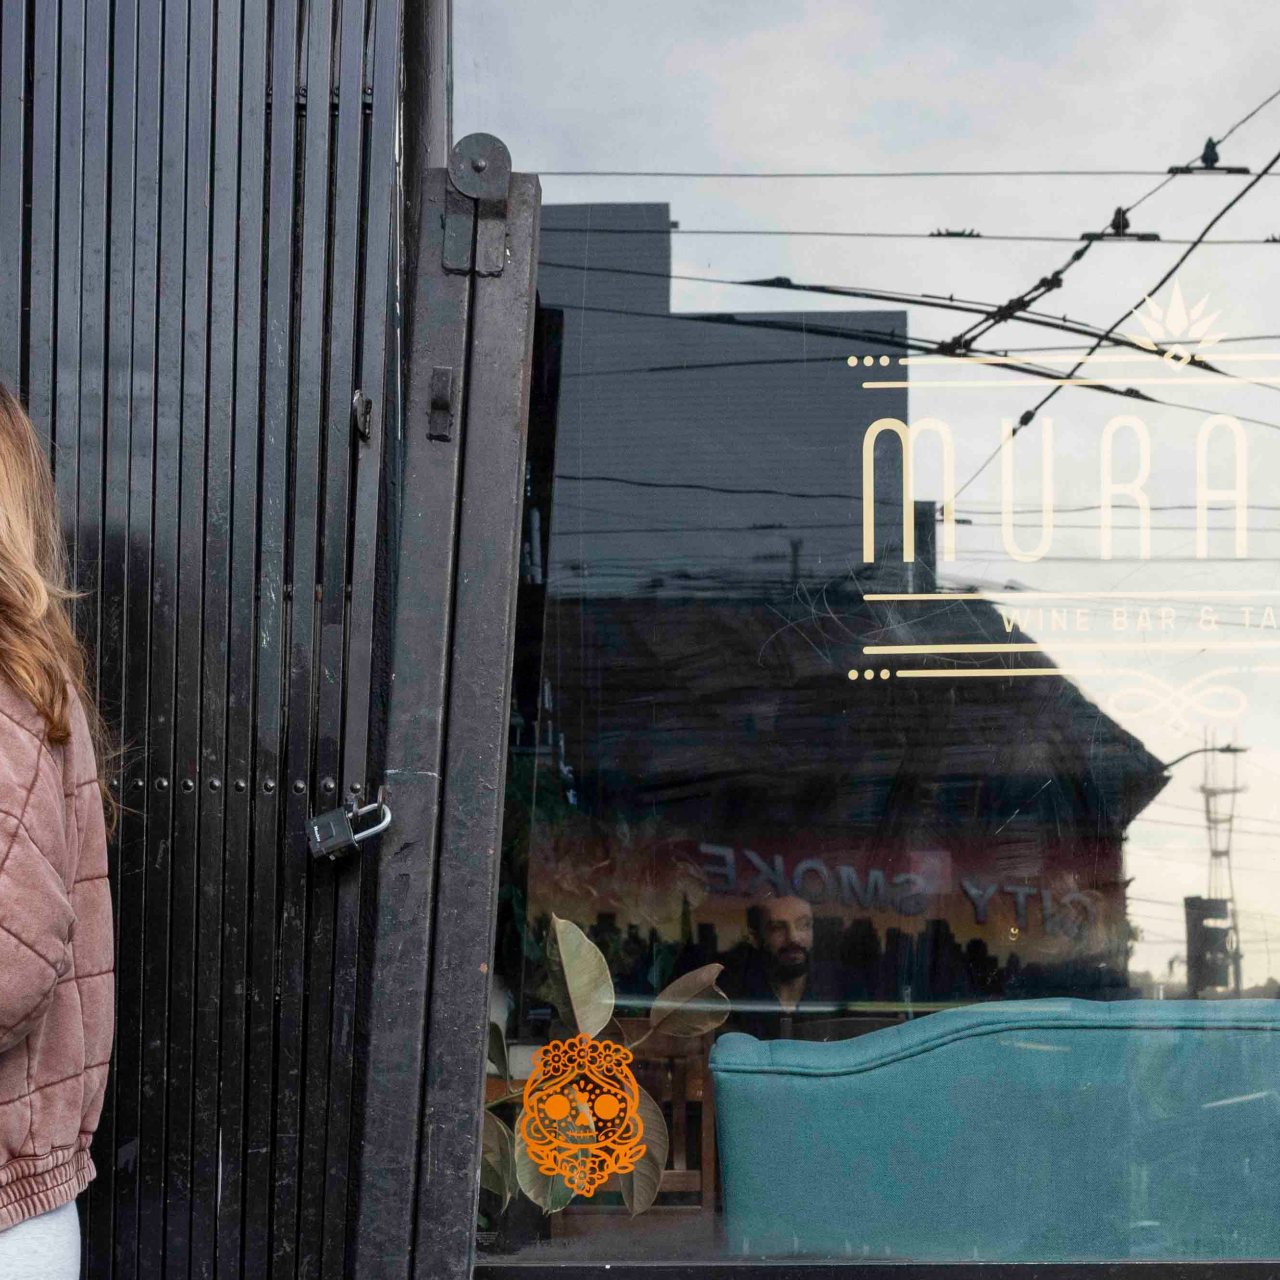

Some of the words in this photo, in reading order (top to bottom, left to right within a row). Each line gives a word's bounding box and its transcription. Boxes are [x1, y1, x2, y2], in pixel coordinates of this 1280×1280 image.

[1001, 607, 1091, 633] WINE
[1111, 606, 1177, 632] BAR
[1199, 607, 1219, 631] &
